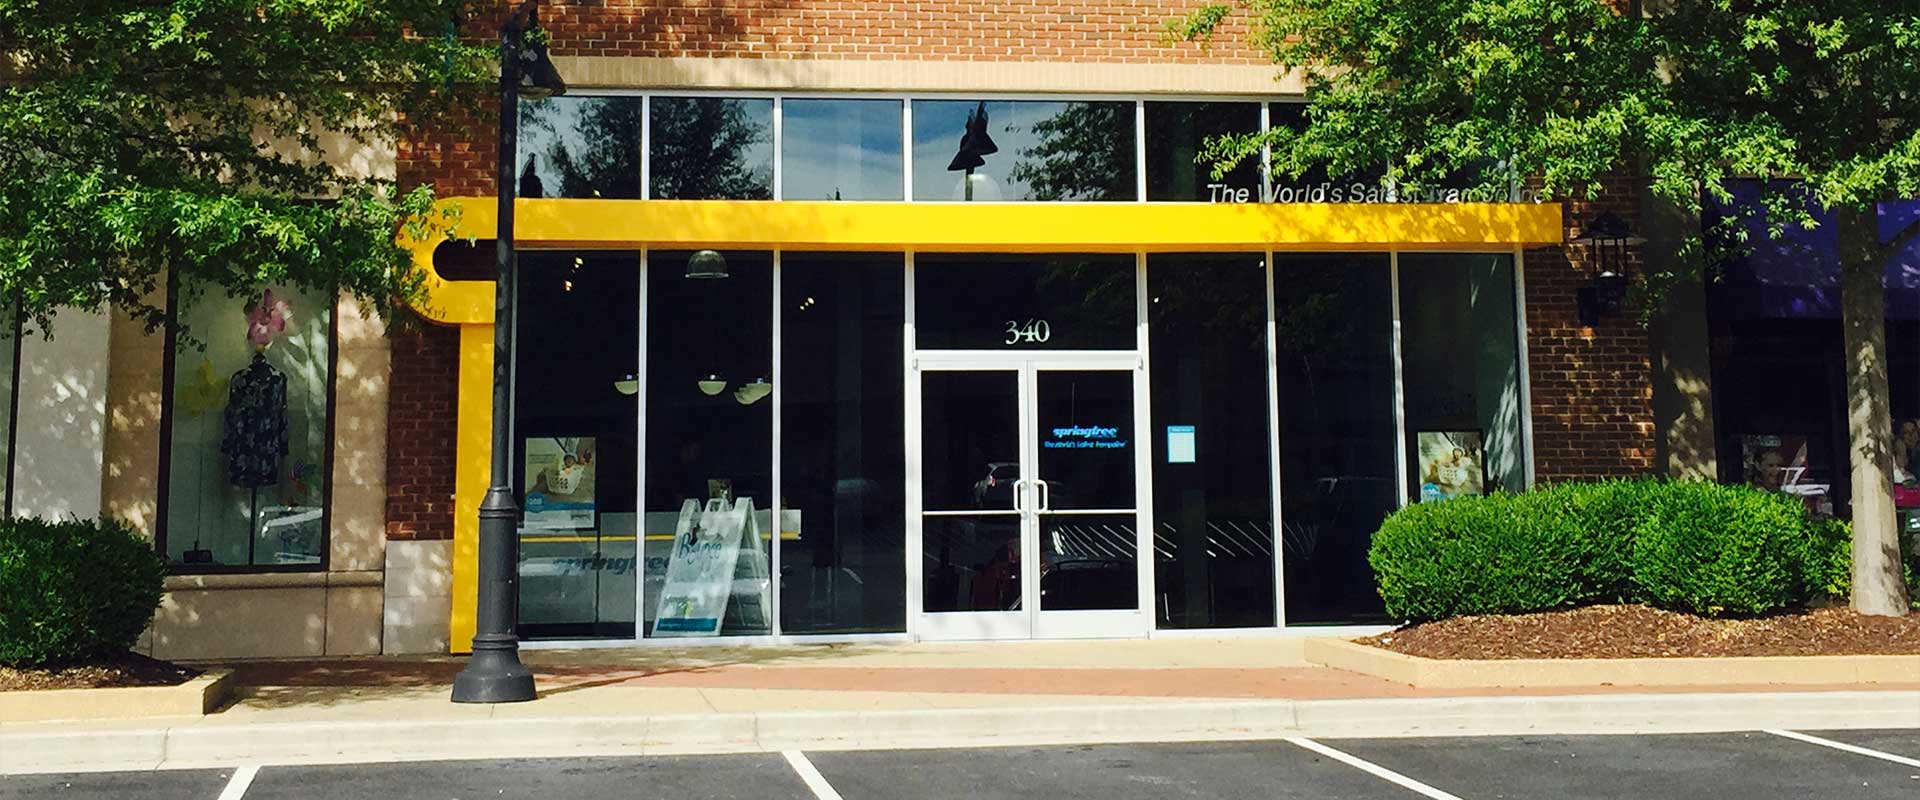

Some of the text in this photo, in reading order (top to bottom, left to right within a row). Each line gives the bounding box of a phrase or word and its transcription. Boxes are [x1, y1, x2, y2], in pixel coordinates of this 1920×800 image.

[1207, 184, 1249, 203] The
[1257, 182, 1343, 203] World's
[1005, 317, 1050, 345] 340
